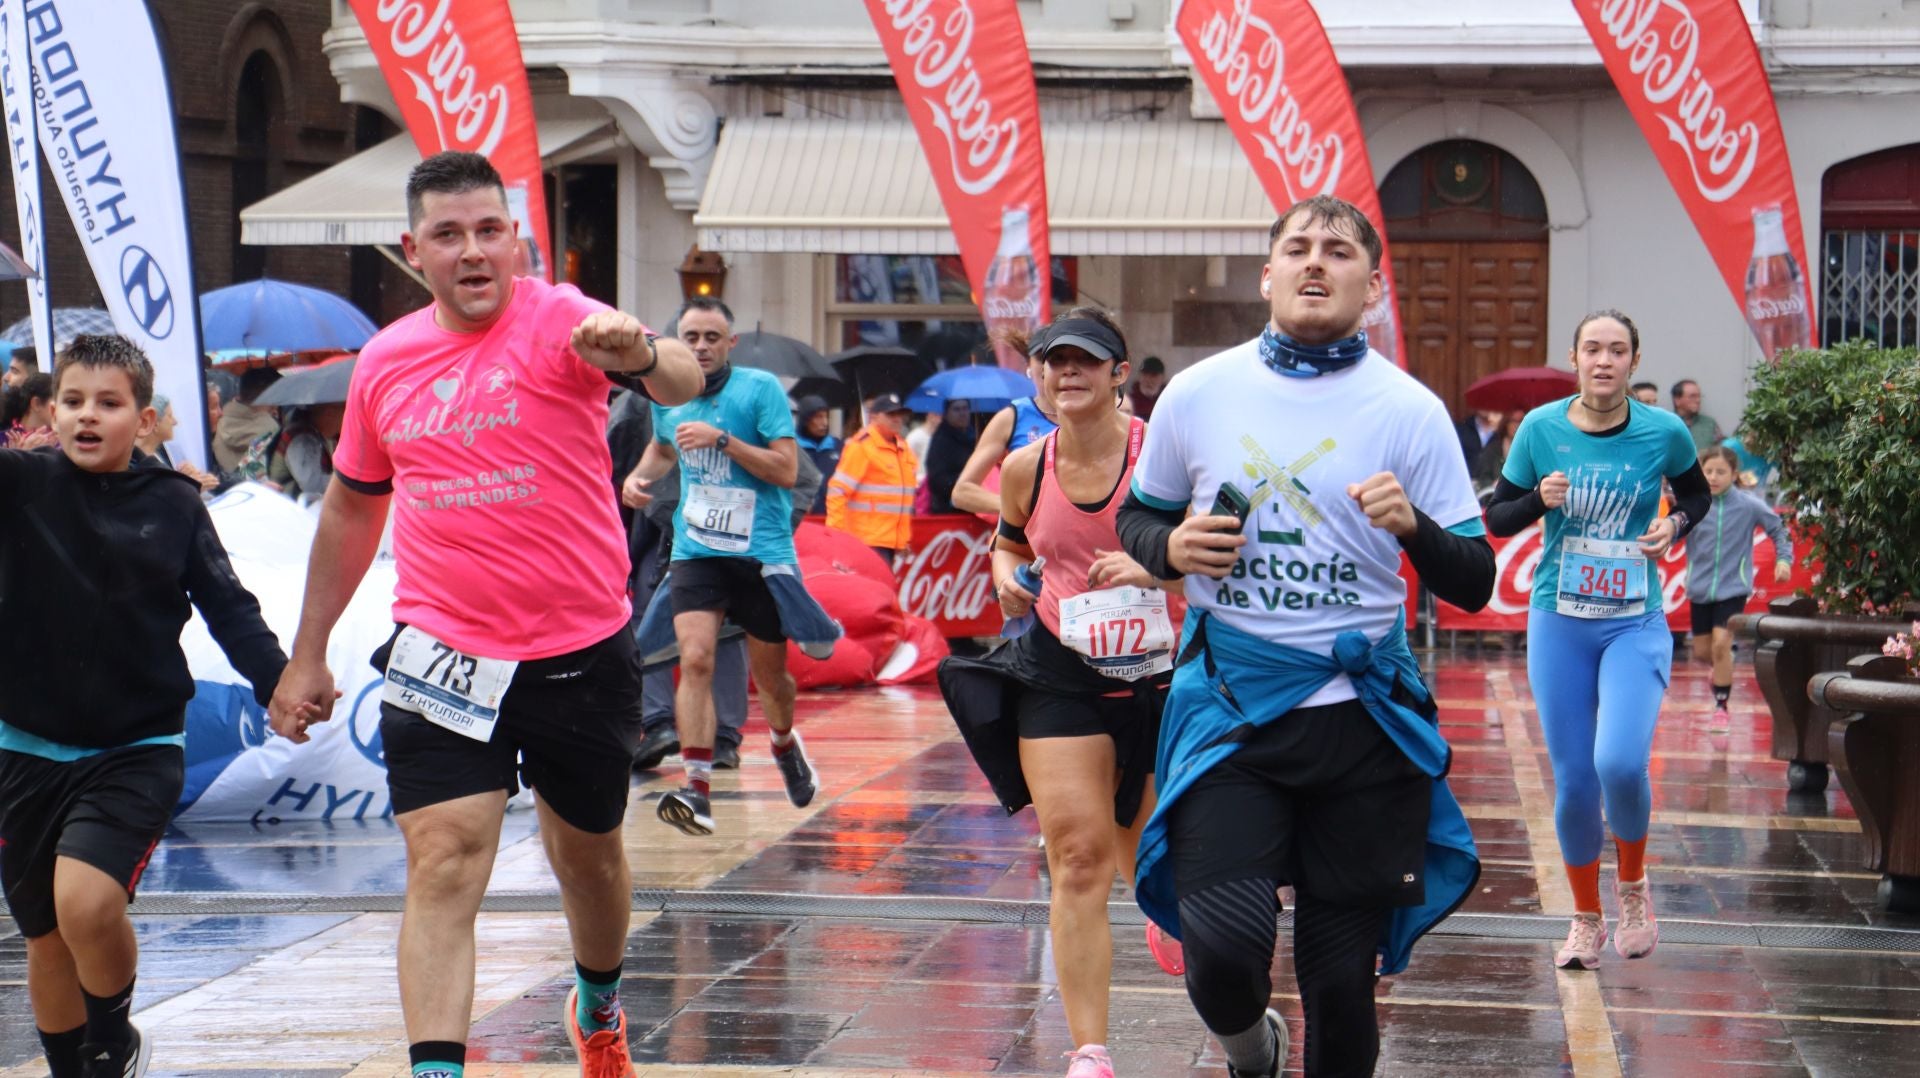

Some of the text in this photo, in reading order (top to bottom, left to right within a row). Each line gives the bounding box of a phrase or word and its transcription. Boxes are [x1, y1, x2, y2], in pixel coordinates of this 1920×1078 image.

[1454, 163, 1468, 182] 9
[478, 463, 537, 486] GANAS
[704, 508, 732, 531] 811
[1211, 553, 1359, 583] actoría
[1579, 565, 1627, 599] 349
[1215, 583, 1362, 611] de Verde
[1101, 608, 1132, 619] MIRIAM
[1088, 618, 1148, 657] 1172
[421, 641, 478, 697] 713
[1105, 660, 1155, 676] HYUNDAI
[417, 696, 475, 728] HYUNDAI
